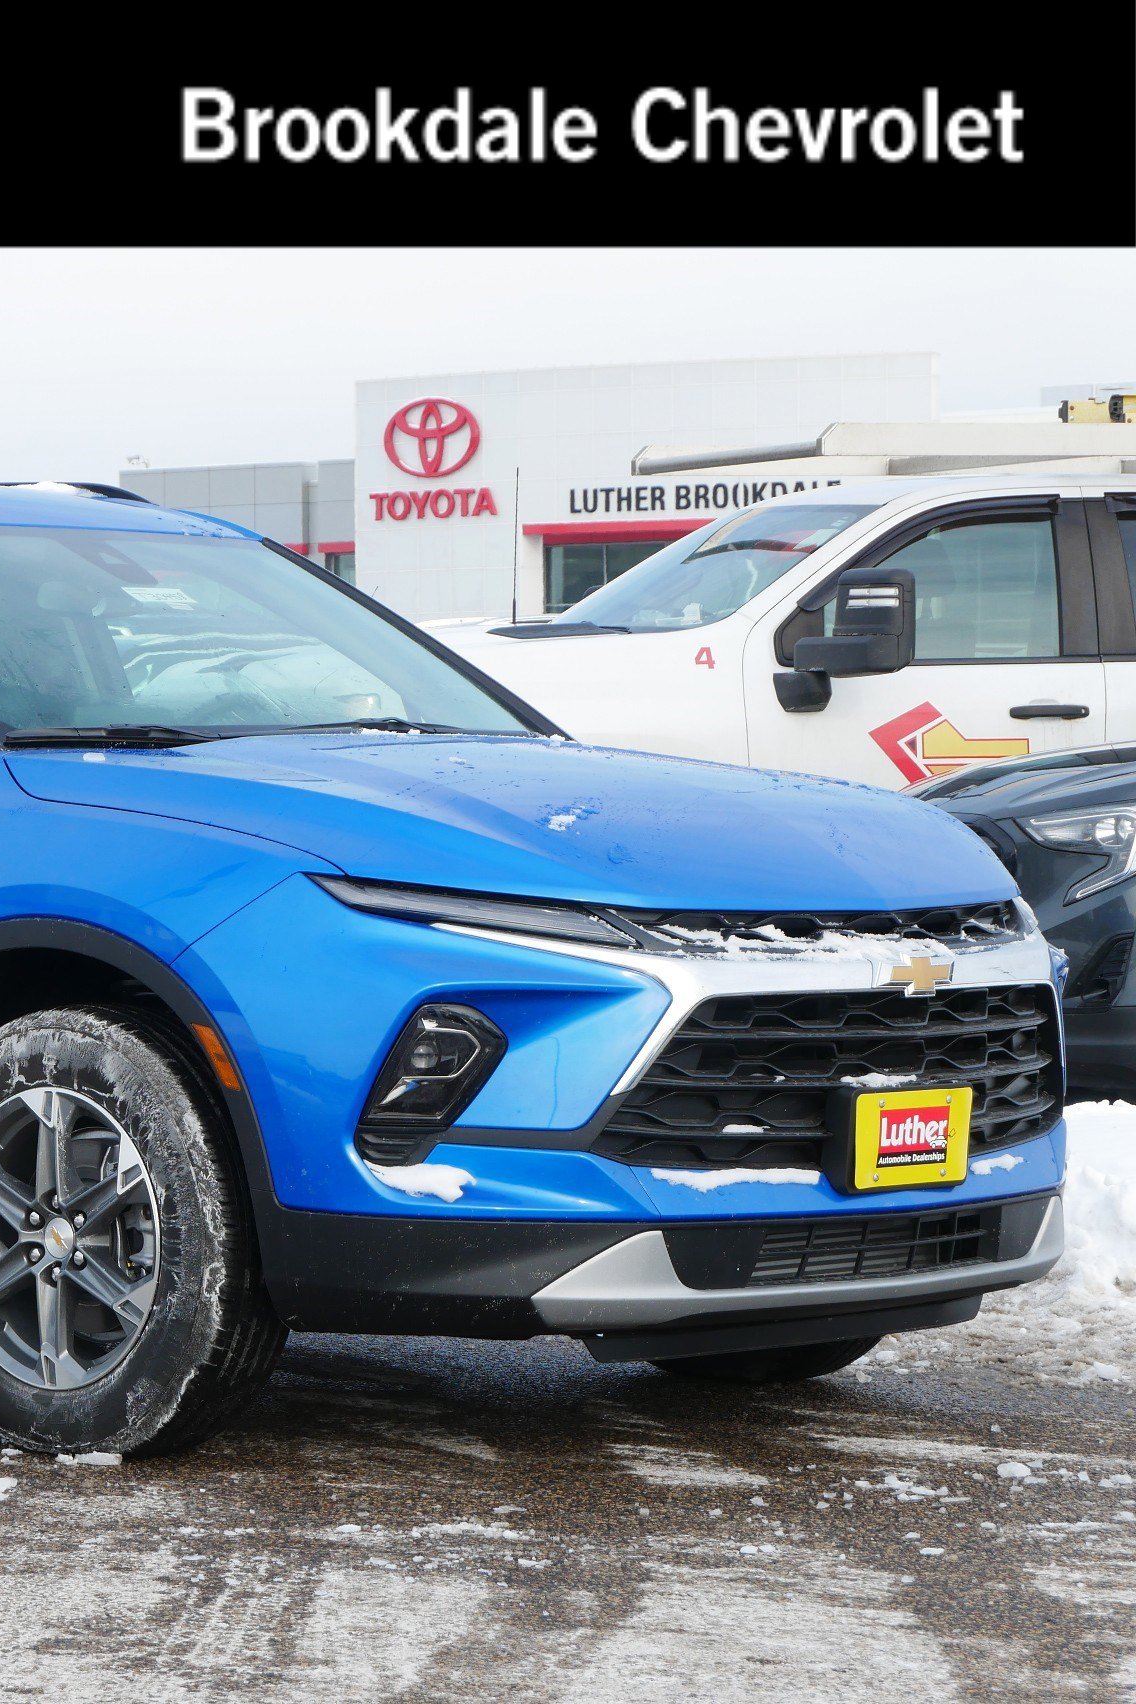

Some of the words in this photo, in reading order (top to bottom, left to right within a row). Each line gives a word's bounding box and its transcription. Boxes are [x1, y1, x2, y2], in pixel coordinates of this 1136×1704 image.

[369, 487, 498, 522] TOYOTA
[569, 485, 665, 514] LUTHER
[694, 646, 716, 669] 4
[880, 1114, 948, 1147] Luther
[878, 1154, 911, 1164] Automobile
[913, 1152, 944, 1161] Dealerships
